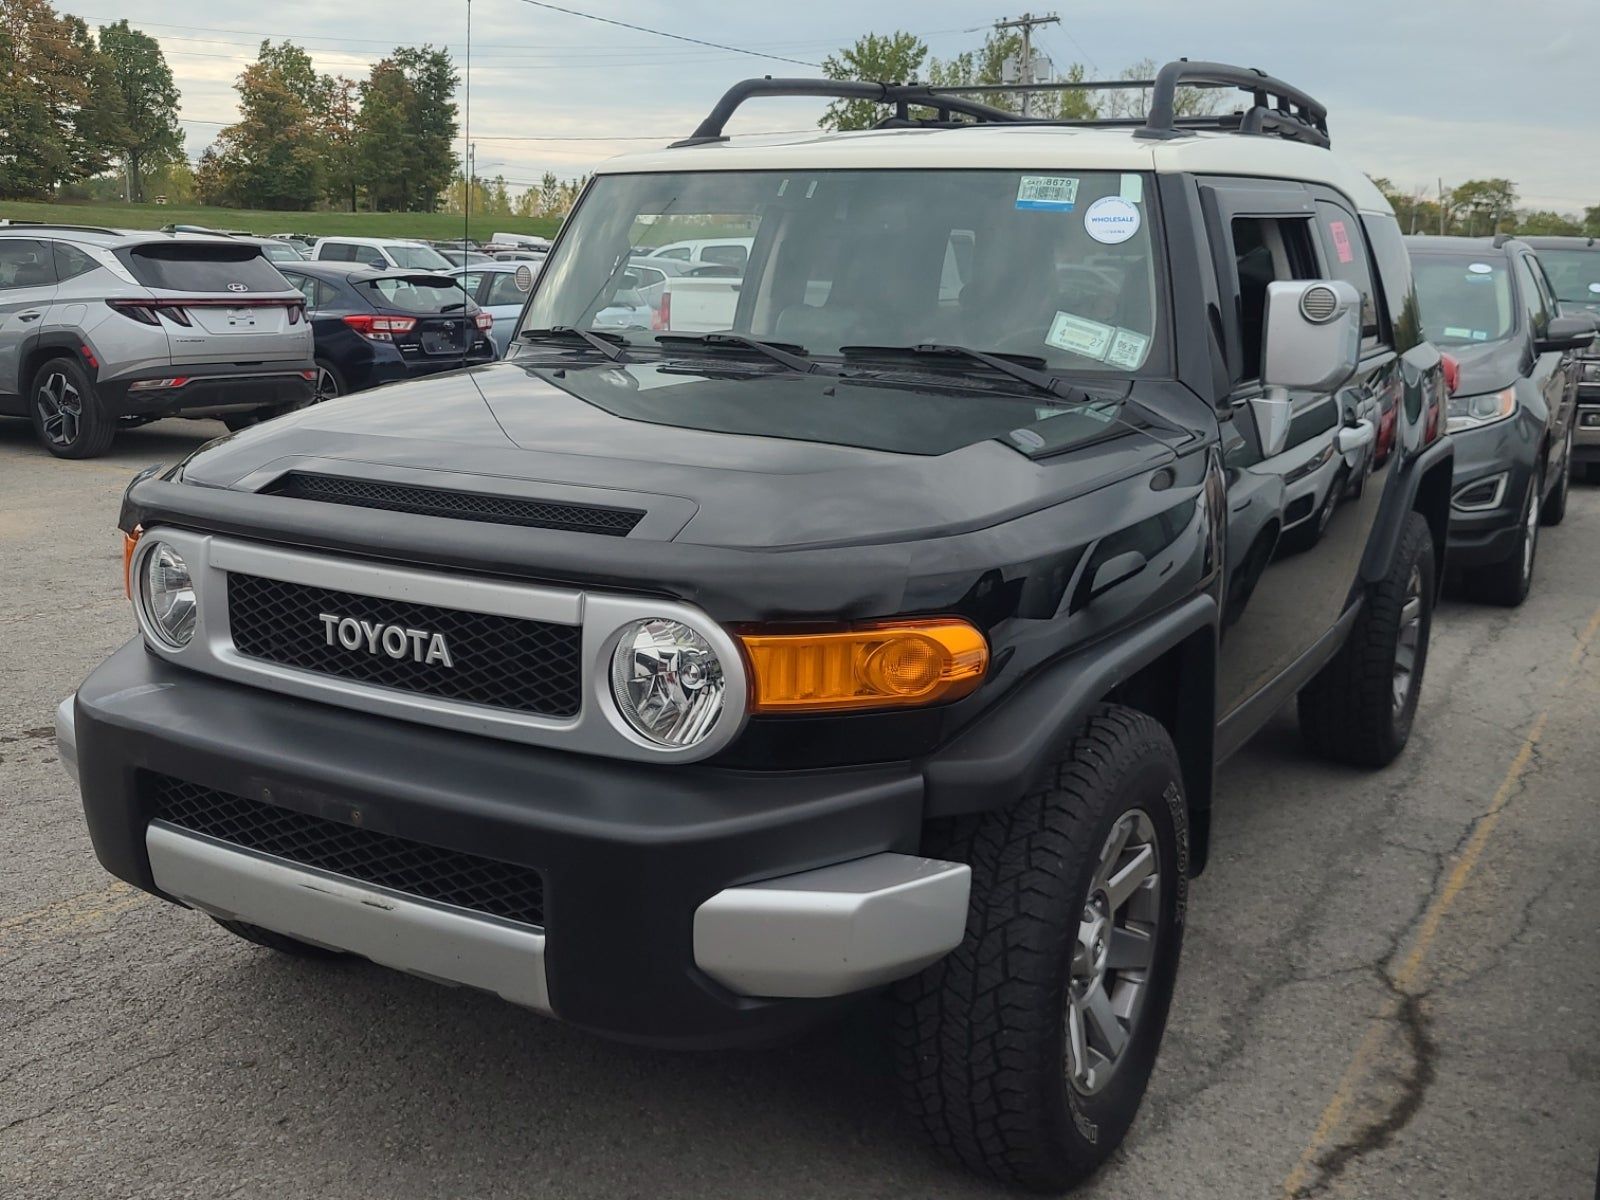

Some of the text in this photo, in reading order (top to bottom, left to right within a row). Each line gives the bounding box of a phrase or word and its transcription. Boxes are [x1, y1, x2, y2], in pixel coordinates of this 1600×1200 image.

[1046, 178, 1072, 187] 8679
[1089, 337, 1105, 348] 27
[319, 613, 454, 668] TOYOTA
